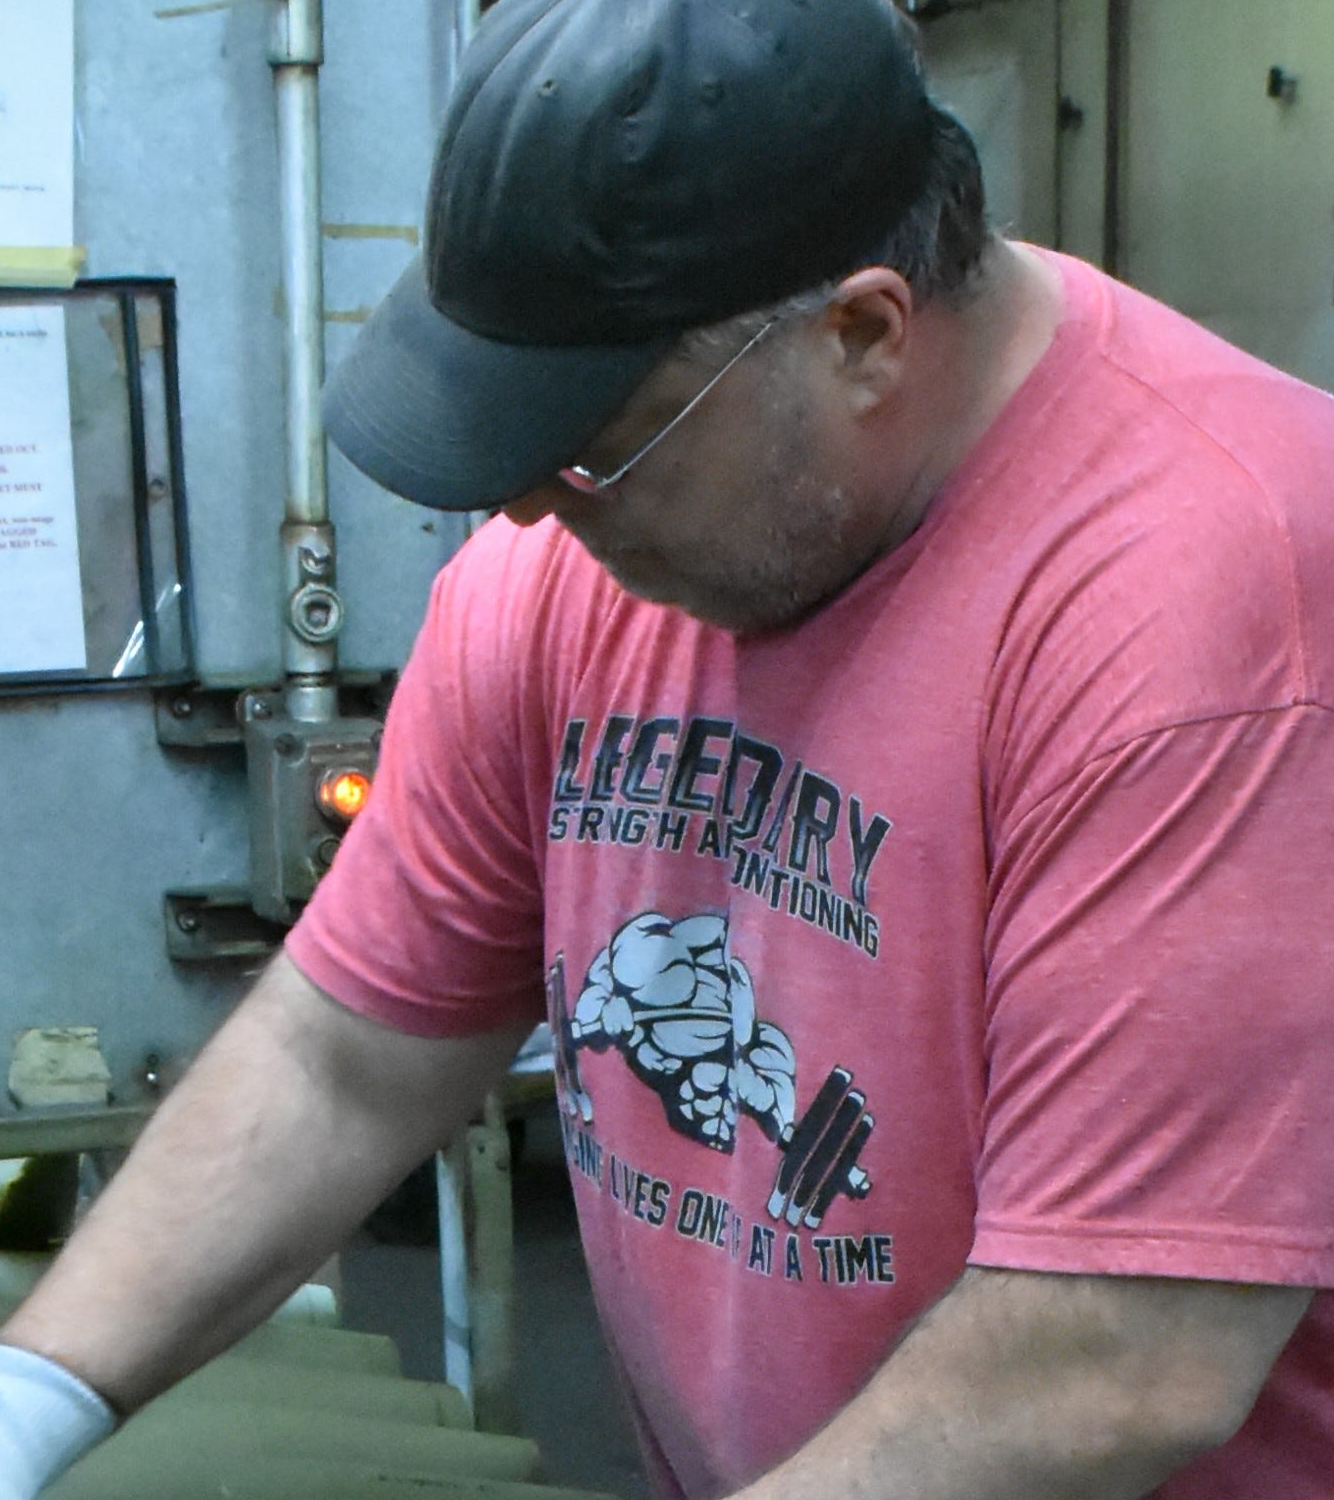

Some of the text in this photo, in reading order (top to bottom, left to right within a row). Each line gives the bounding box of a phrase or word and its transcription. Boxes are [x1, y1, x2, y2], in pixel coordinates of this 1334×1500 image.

[746, 1221, 776, 1278] AT
[784, 1231, 804, 1283] A
[811, 1233, 897, 1286] TIME
